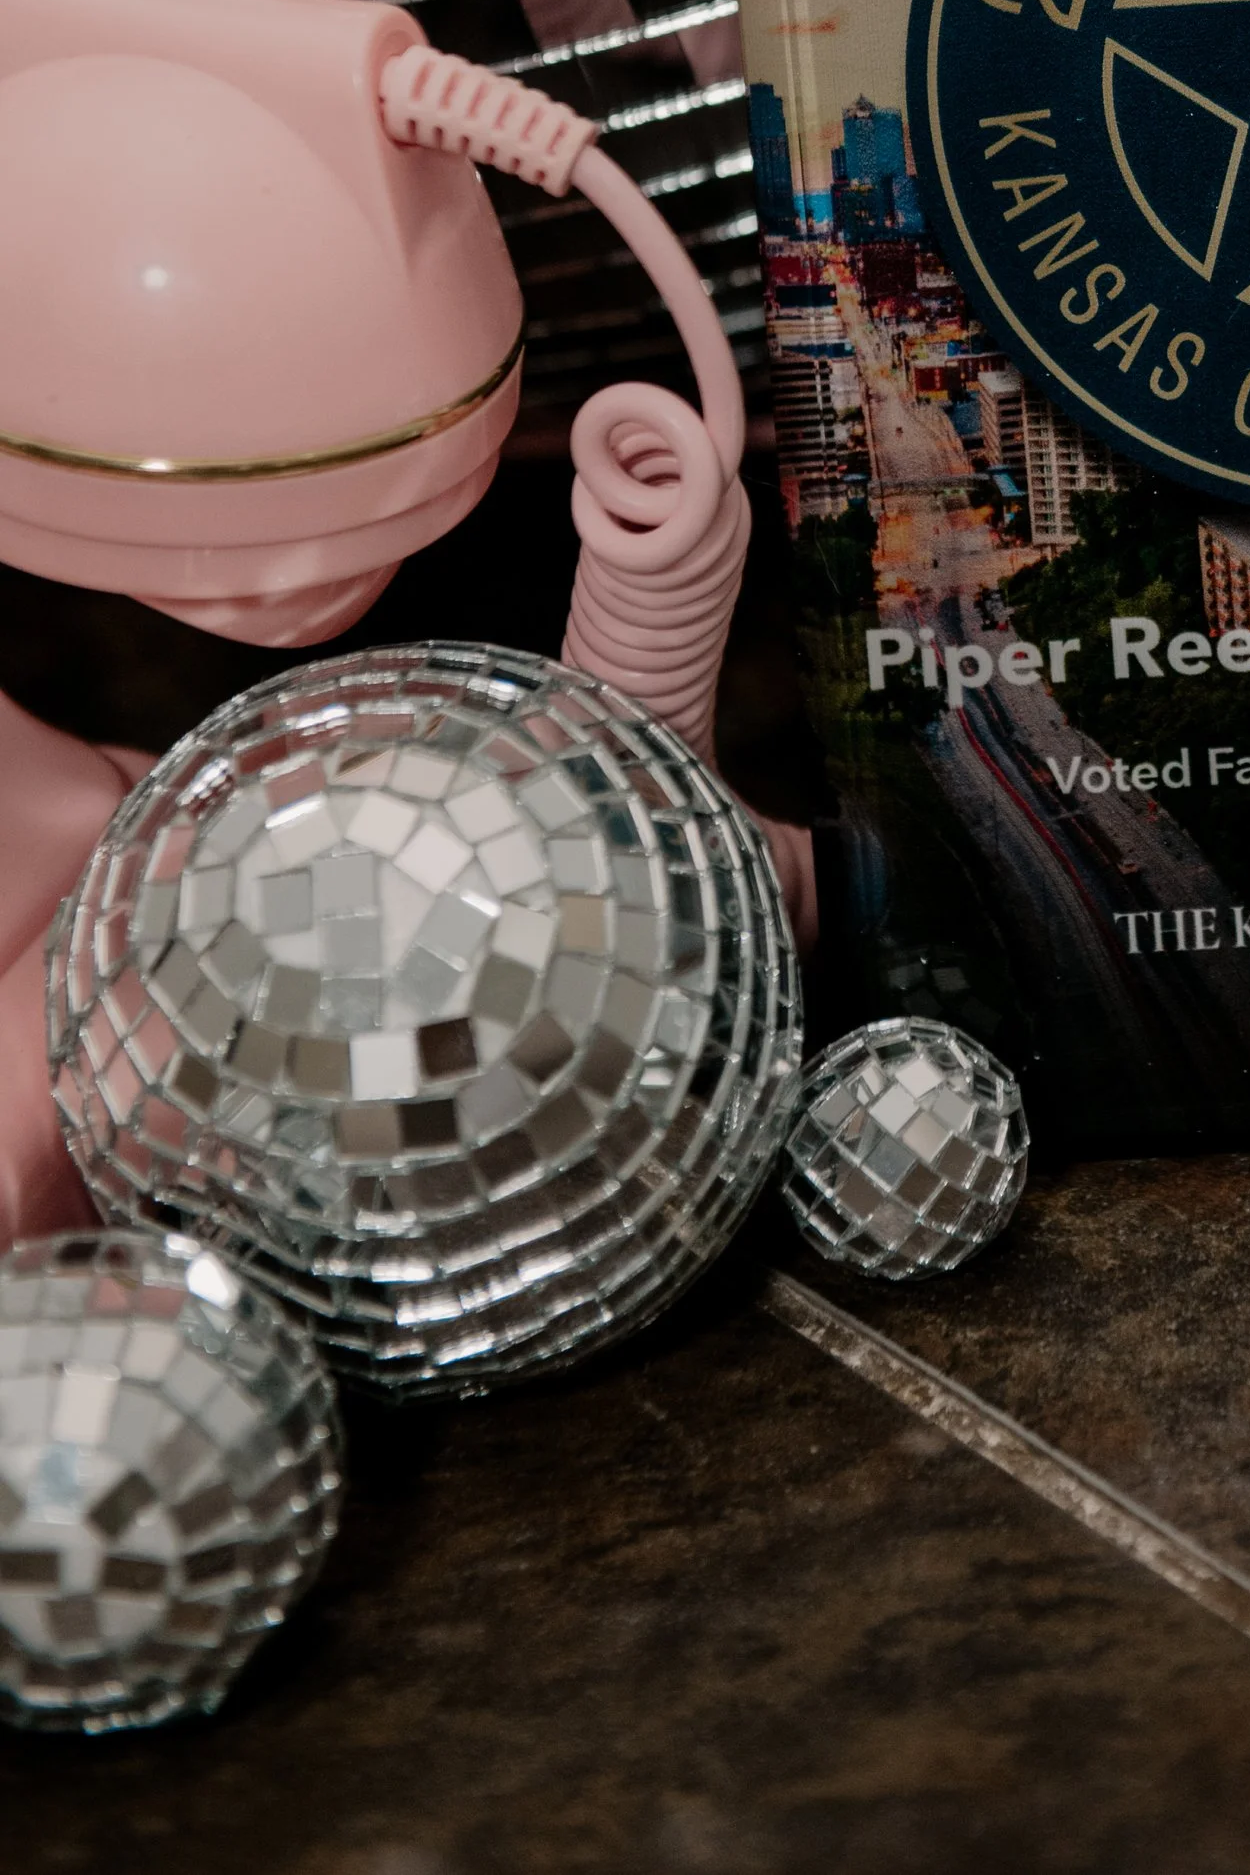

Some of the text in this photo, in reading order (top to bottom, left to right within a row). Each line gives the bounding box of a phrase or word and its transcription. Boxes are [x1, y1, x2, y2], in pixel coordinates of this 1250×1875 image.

[978, 108, 1206, 402] KANSAS
[865, 627, 1081, 710] Piper
[1046, 746, 1192, 795] Voted
[1113, 906, 1221, 955] THE
